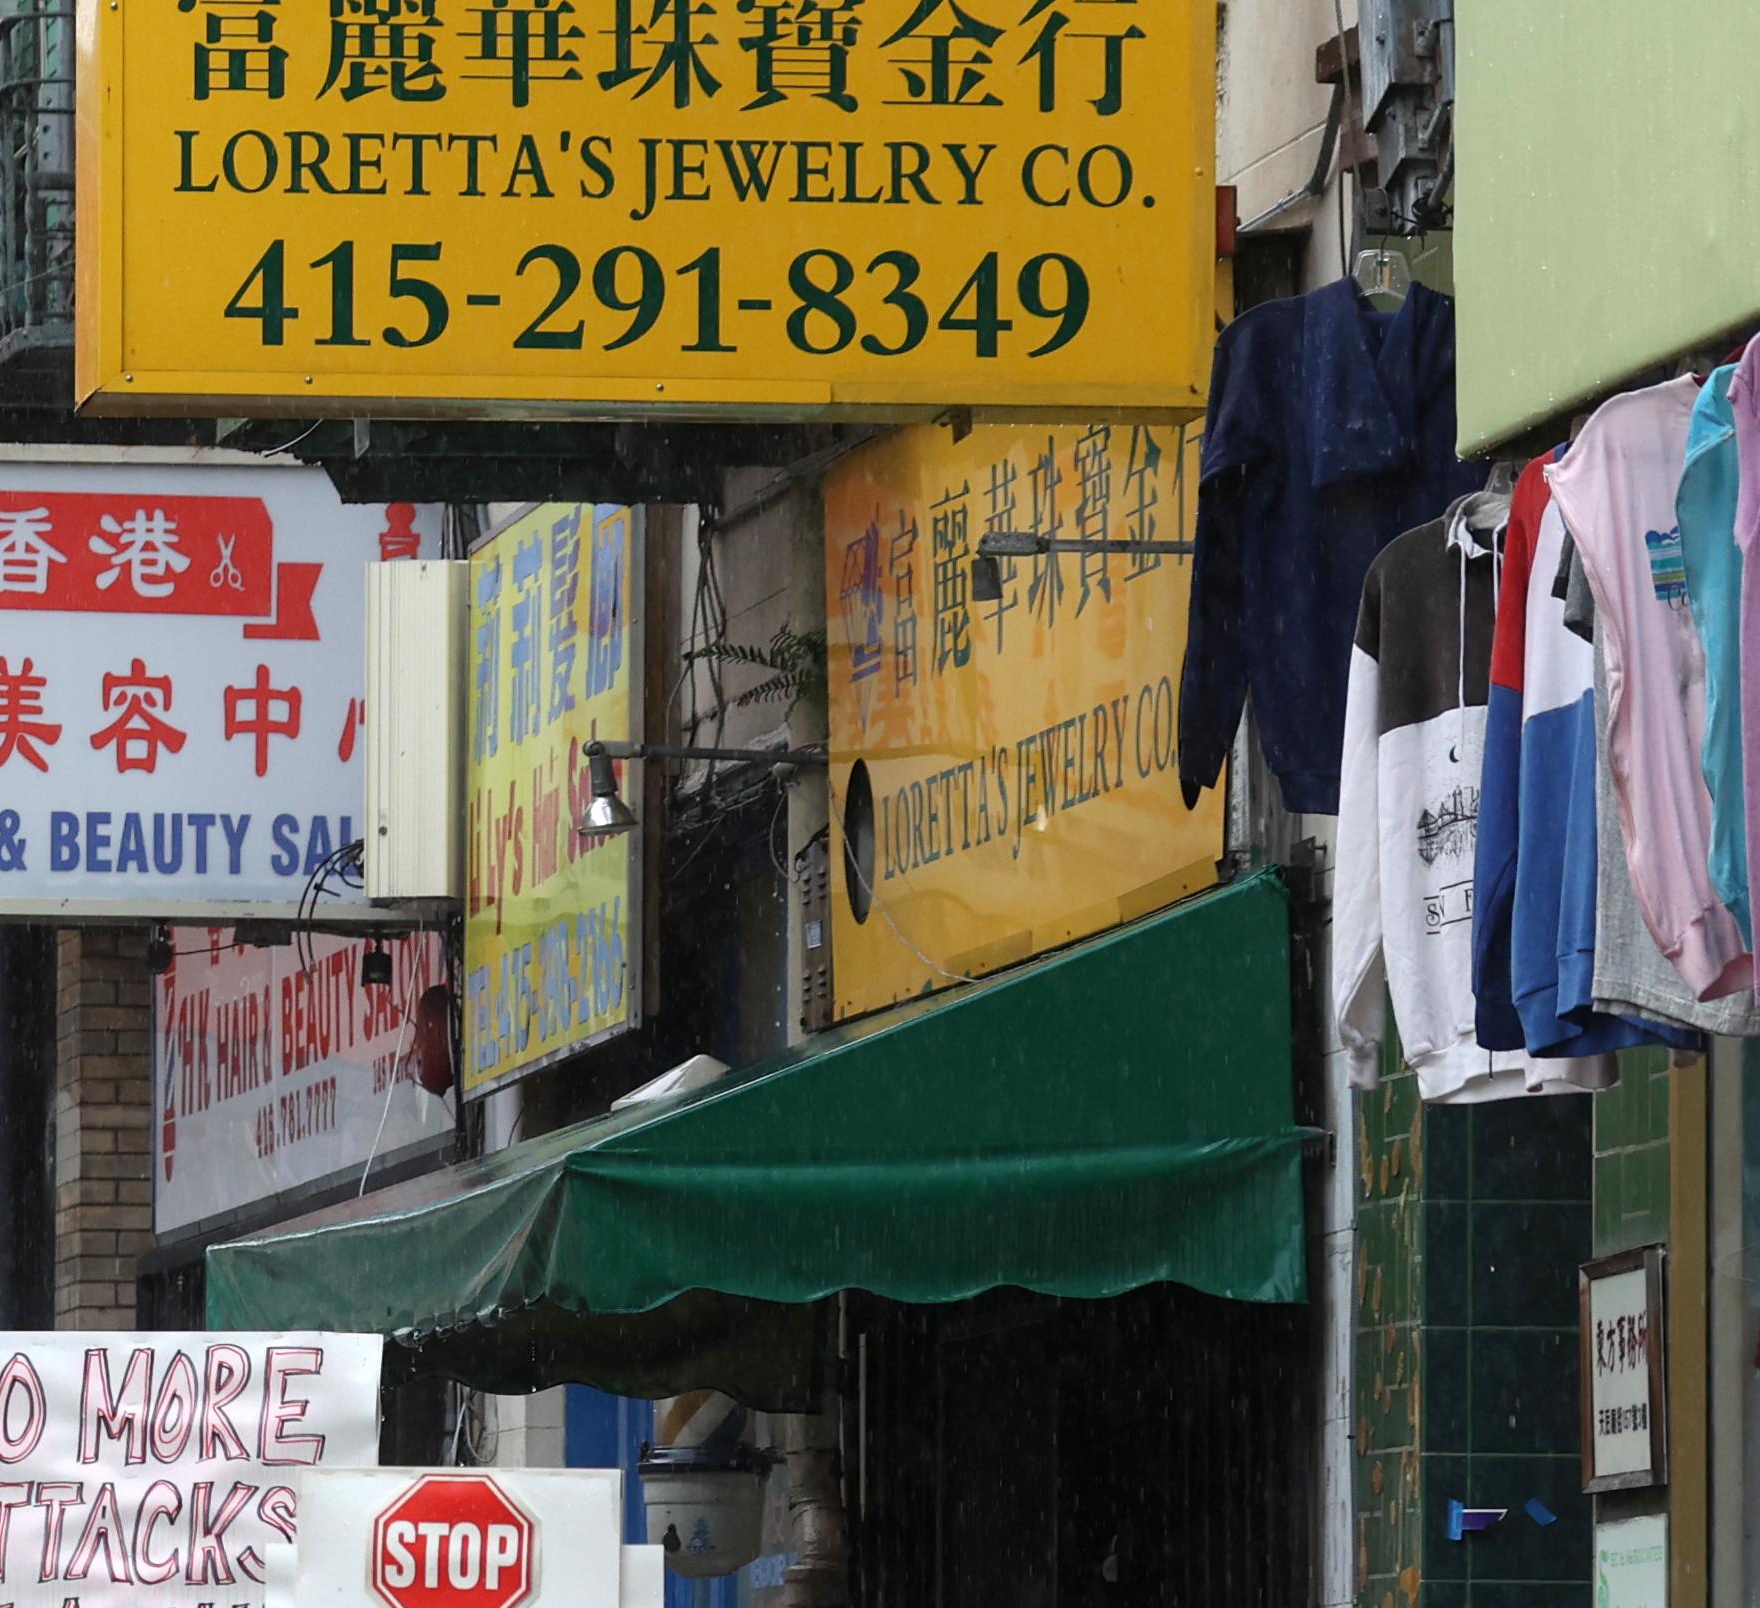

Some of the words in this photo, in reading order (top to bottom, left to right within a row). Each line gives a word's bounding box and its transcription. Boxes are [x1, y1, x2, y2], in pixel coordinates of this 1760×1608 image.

[173, 130, 615, 205] LORETTA'S
[629, 138, 997, 221] JEWELRY
[1021, 145, 1157, 210] CO.
[224, 240, 1091, 361] 415-291-8349
[882, 745, 1010, 881] LORETTA'S
[1011, 694, 1129, 861] JEWELRY
[1135, 675, 1181, 779] CO.
[51, 812, 253, 875] BEAUTY
[217, 992, 259, 1102] HAIR
[282, 942, 358, 1077] BEAUTY
[79, 1345, 326, 1467] MORE
[382, 1518, 521, 1591] STOP
